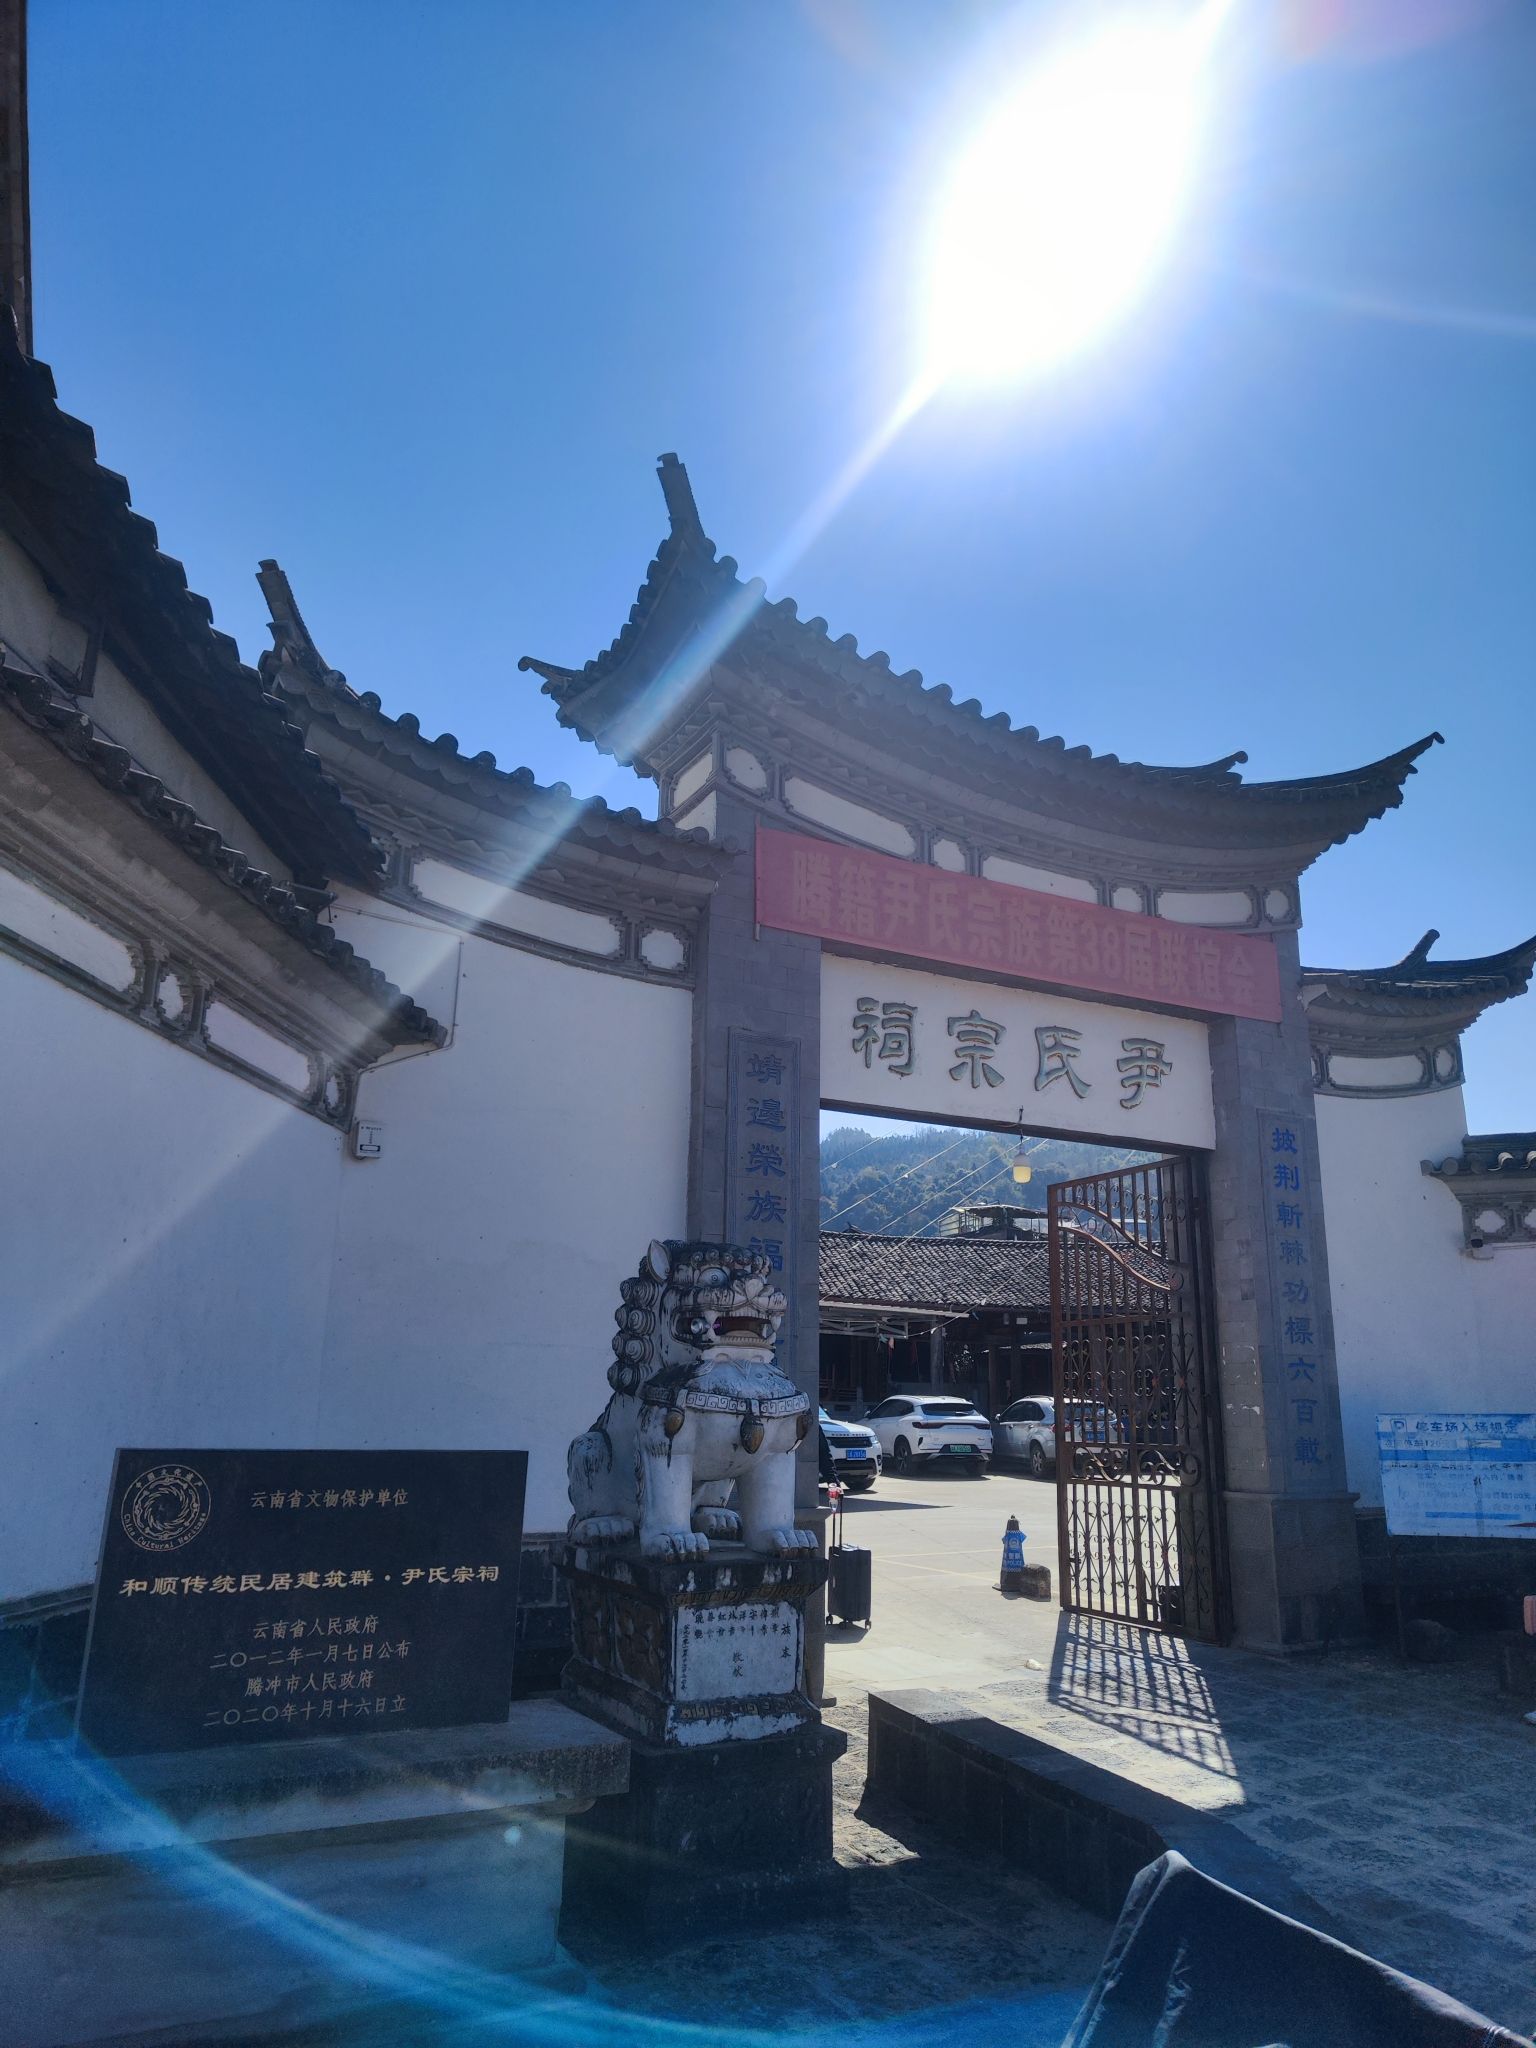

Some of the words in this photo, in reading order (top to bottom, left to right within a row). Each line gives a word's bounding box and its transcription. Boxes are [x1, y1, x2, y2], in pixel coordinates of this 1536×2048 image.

[250, 1488, 409, 1509] 云南省文物保护单位
[252, 1615, 379, 1640] 云南省人民政府
[244, 1669, 375, 1698] 腾冲市人民政府
